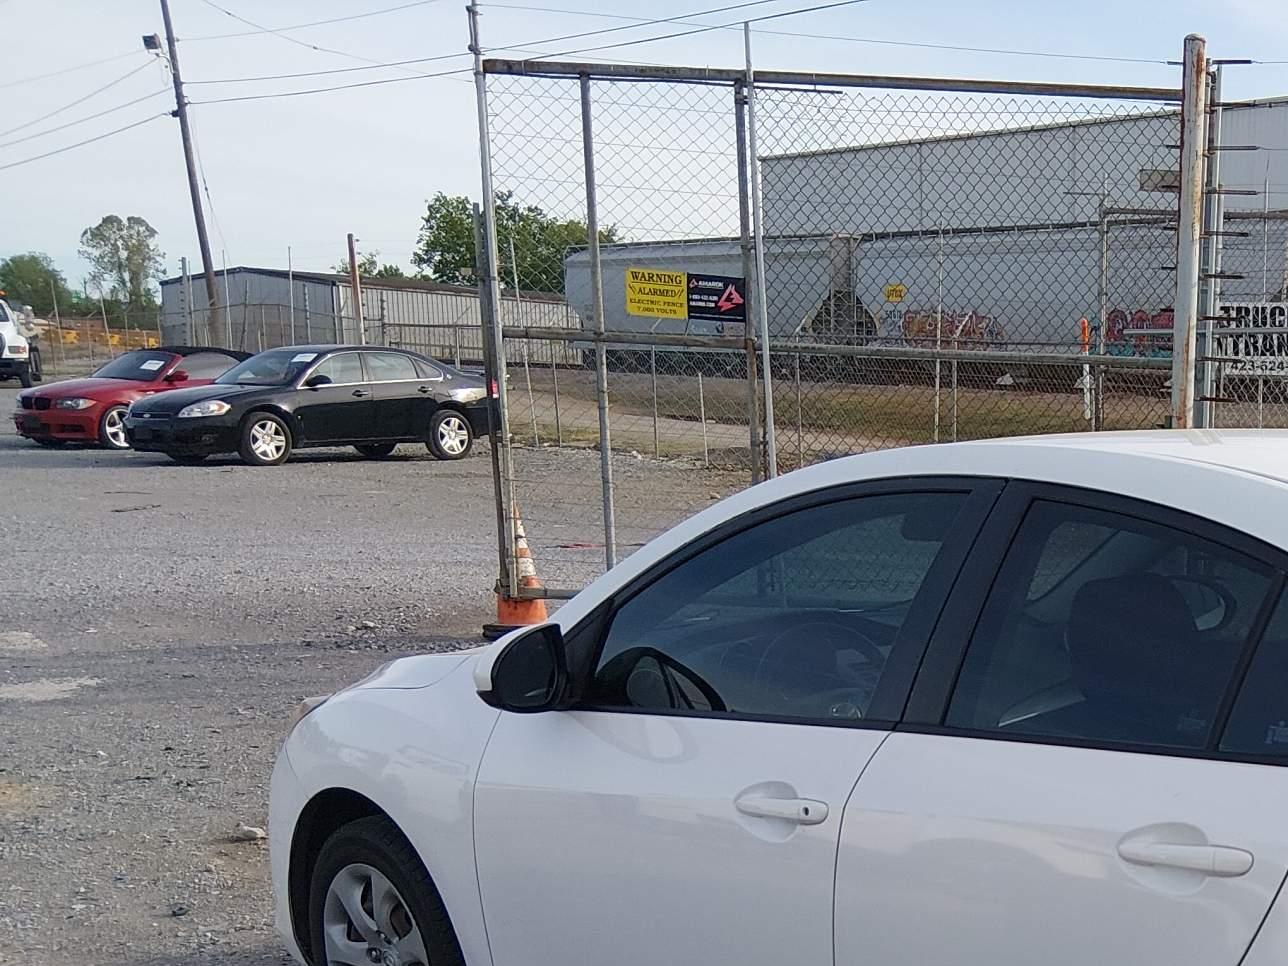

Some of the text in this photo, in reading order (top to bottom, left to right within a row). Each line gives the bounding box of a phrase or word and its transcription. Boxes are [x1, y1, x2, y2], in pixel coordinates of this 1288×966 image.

[631, 271, 682, 285] WARNING
[637, 286, 677, 298] ALARMED
[630, 297, 661, 306] ELECTRIC
